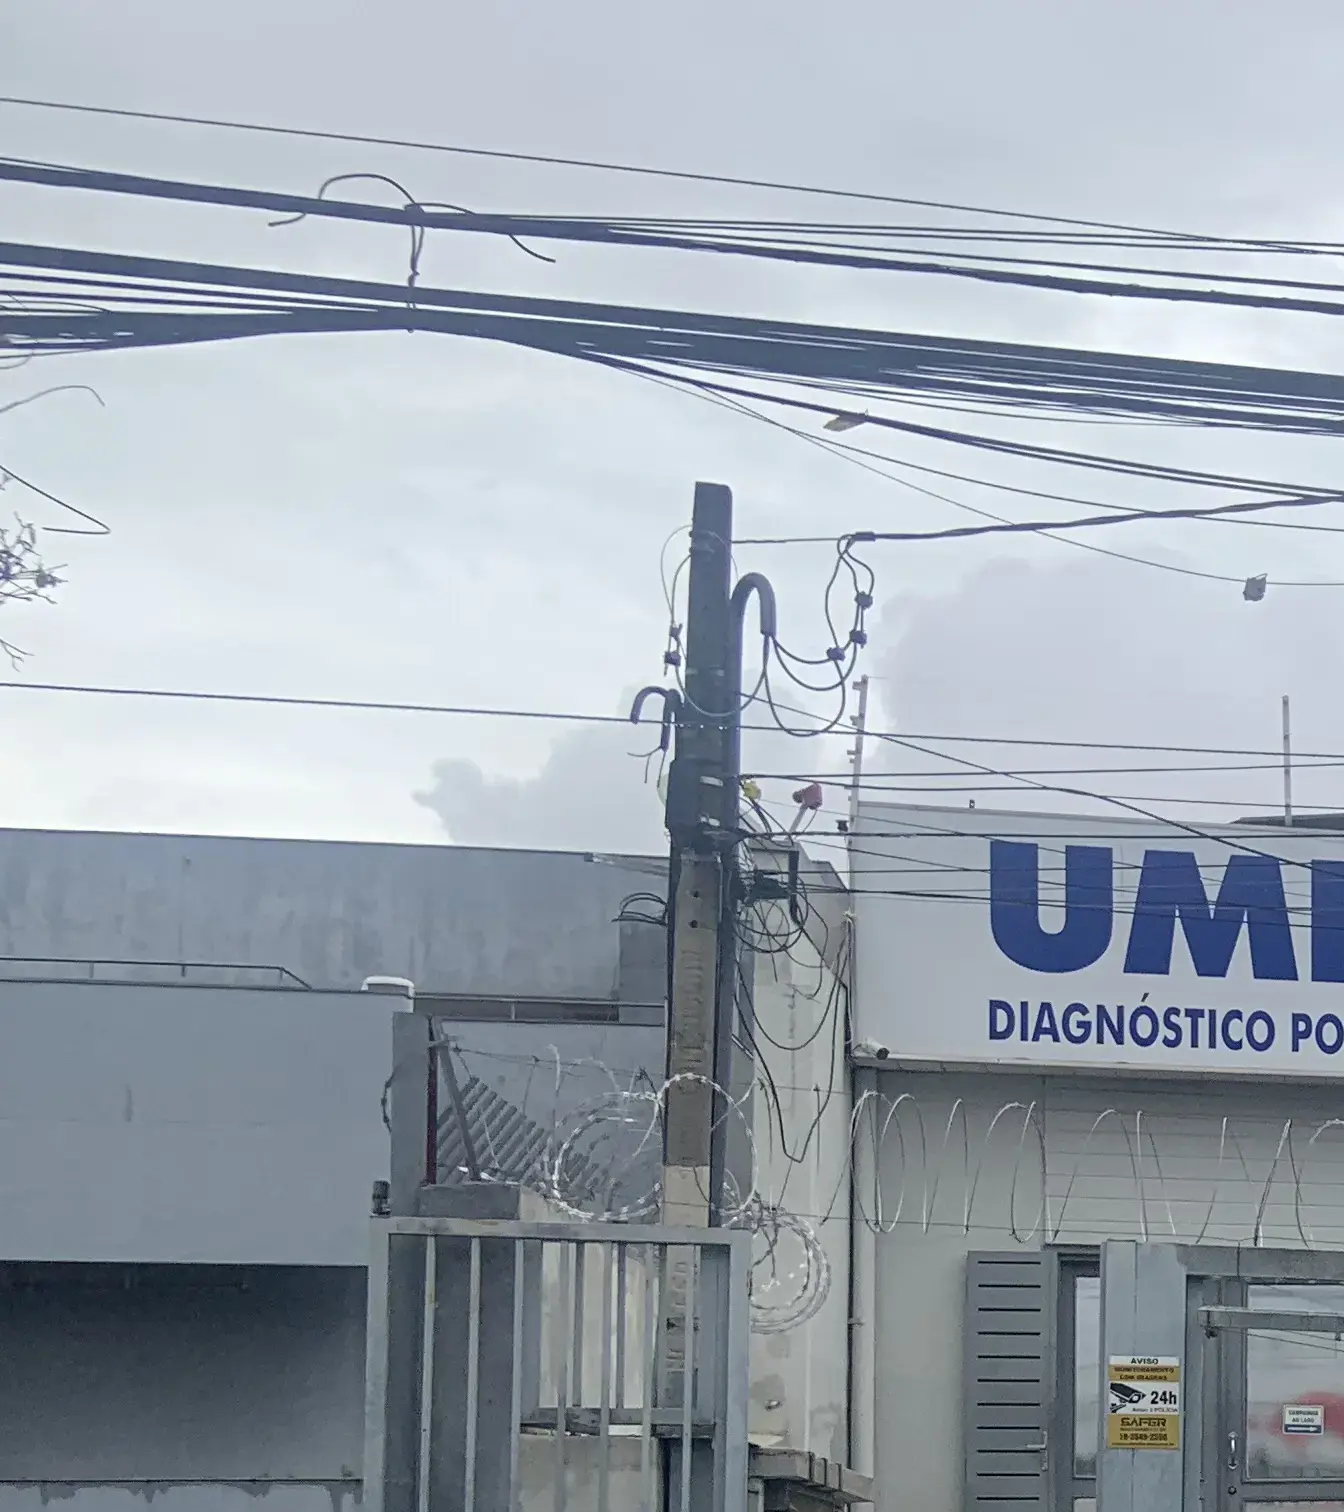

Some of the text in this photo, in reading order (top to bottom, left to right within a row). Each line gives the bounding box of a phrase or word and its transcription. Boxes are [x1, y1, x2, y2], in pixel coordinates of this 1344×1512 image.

[988, 993, 1276, 1051] DIAGNÓSTICO
[1130, 1357, 1159, 1365] AVISO
[1150, 1391, 1177, 1405] 24h
[1120, 1417, 1167, 1427] SAFER
